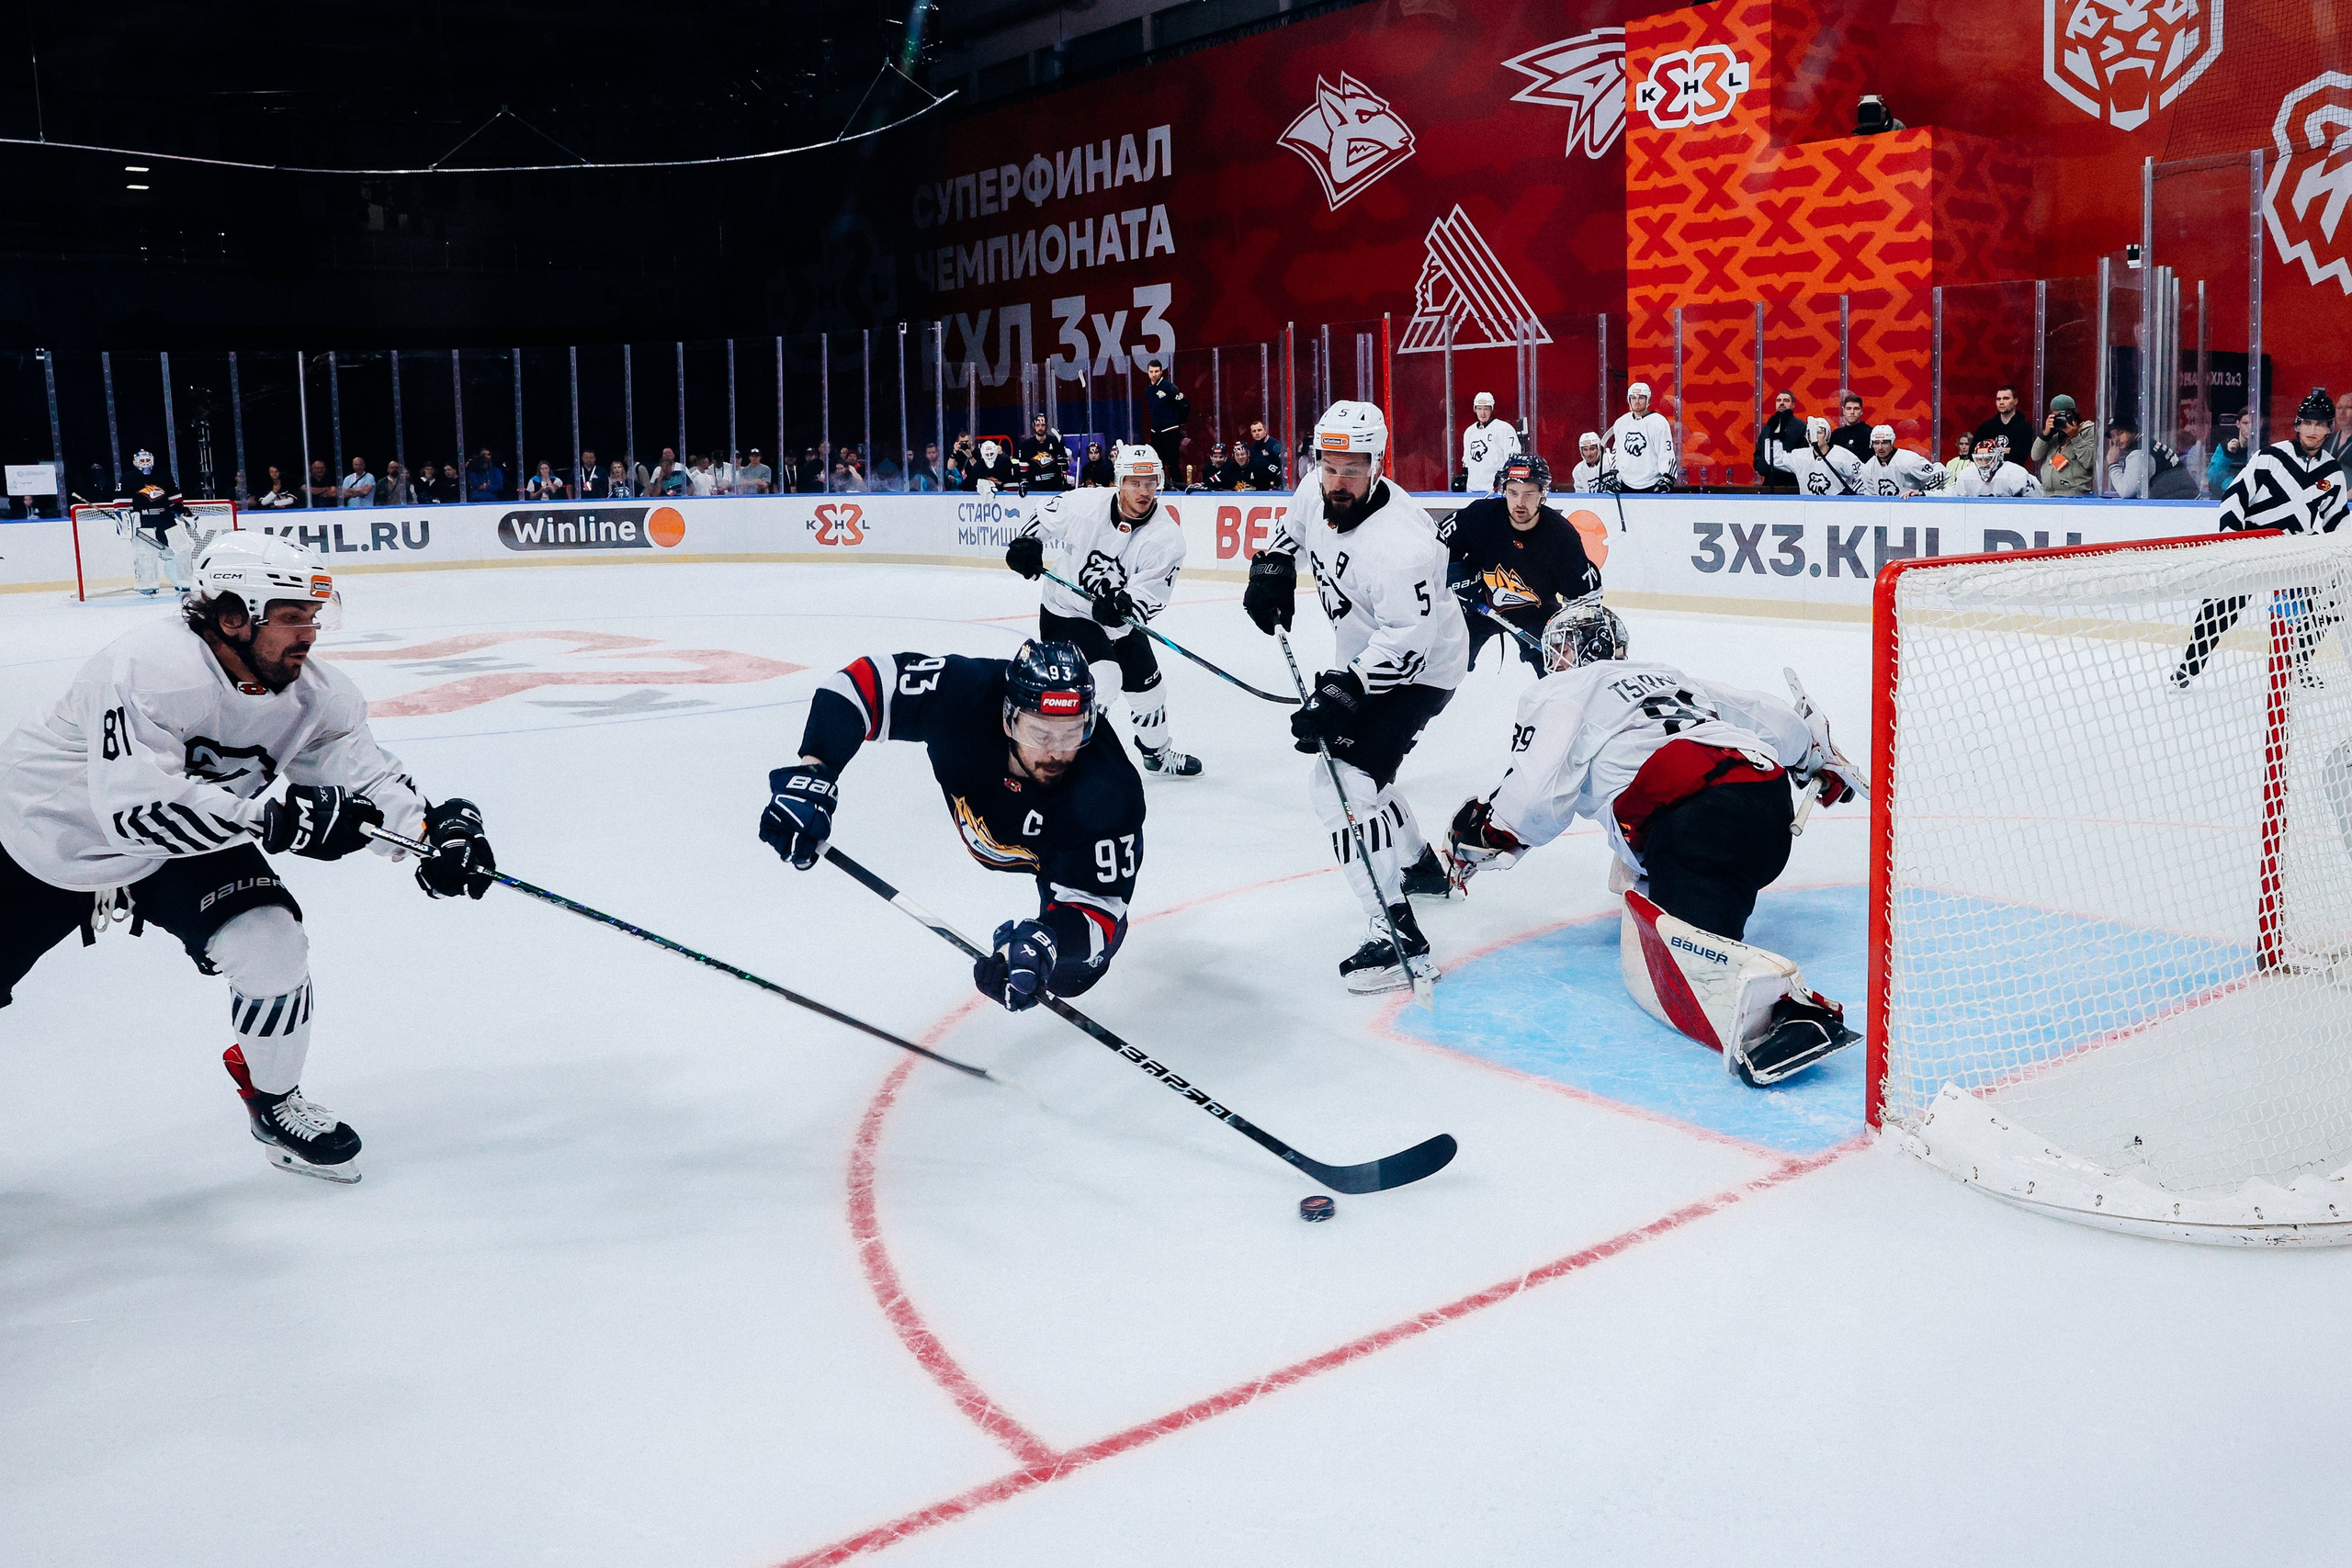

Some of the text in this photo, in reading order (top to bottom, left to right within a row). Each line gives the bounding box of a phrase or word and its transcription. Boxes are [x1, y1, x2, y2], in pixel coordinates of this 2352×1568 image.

[913, 124, 1171, 229] СУПЕРФИНАЛ
[915, 203, 1175, 292] ЧЕМПИОНАТА
[921, 303, 1033, 391] КХЛ
[1134, 449, 1147, 457] 47
[958, 503, 1001, 523] СТАРО
[511, 517, 636, 544] Winline
[1335, 551, 1350, 580] A
[1414, 580, 1430, 616] 5
[899, 657, 945, 695] 93
[1049, 665, 1071, 682] 93
[1043, 698, 1079, 707] FONBET
[103, 706, 133, 761] 81
[1023, 809, 1044, 836] C
[1094, 833, 1136, 884] 93
